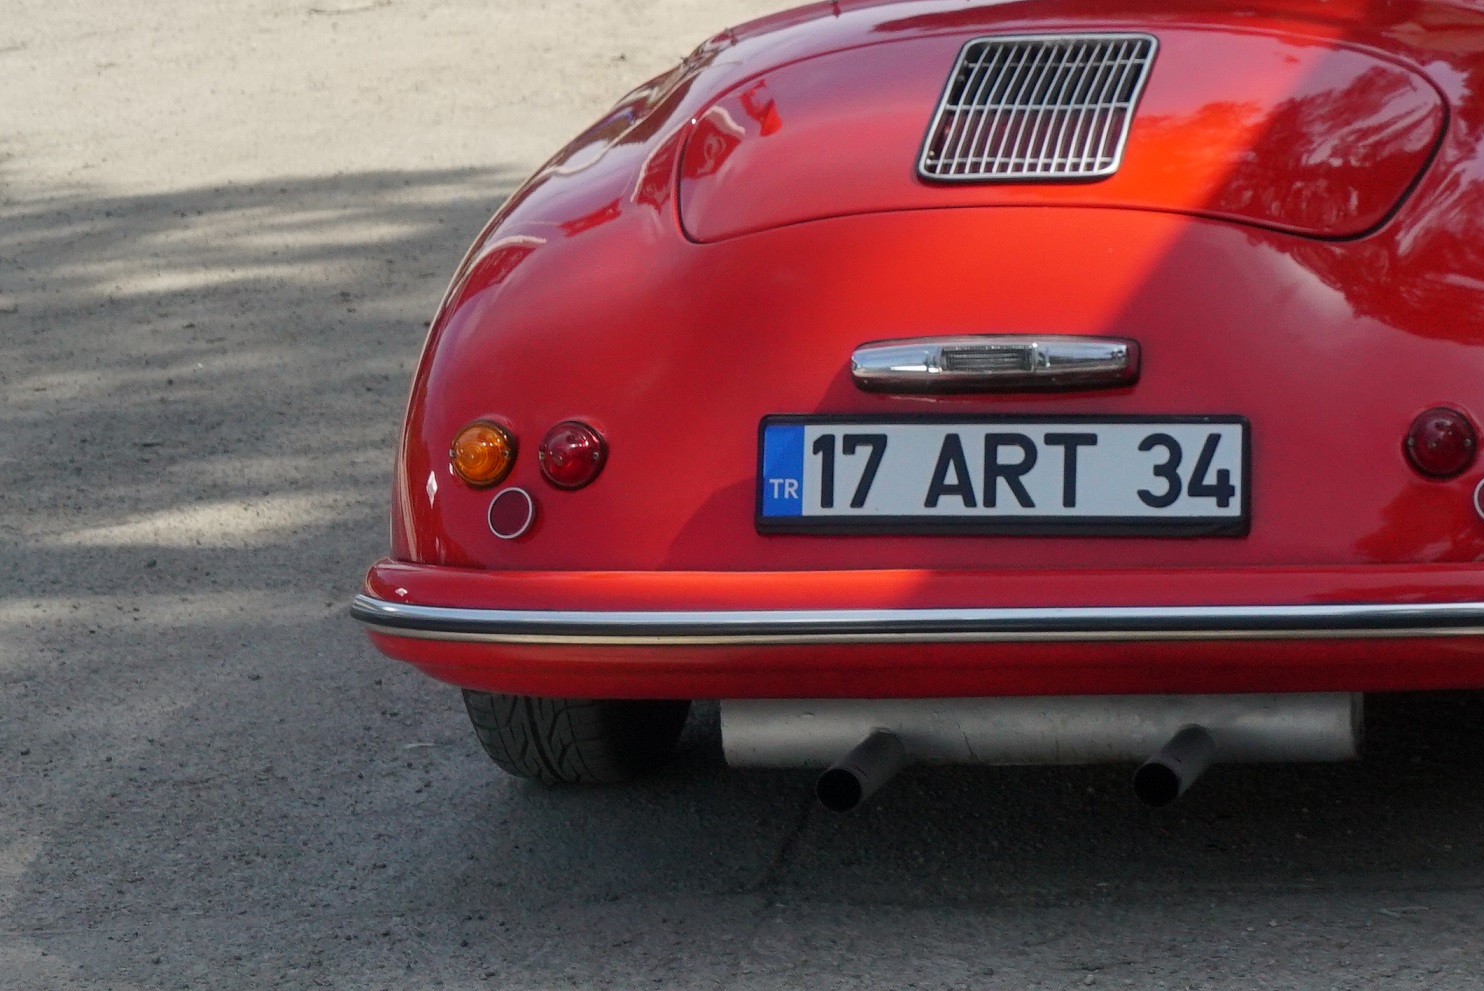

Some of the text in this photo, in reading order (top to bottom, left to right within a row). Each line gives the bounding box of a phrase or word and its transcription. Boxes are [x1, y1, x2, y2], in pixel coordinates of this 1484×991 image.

[769, 478, 799, 500] TR
[812, 432, 1235, 508] 17 ART 34
